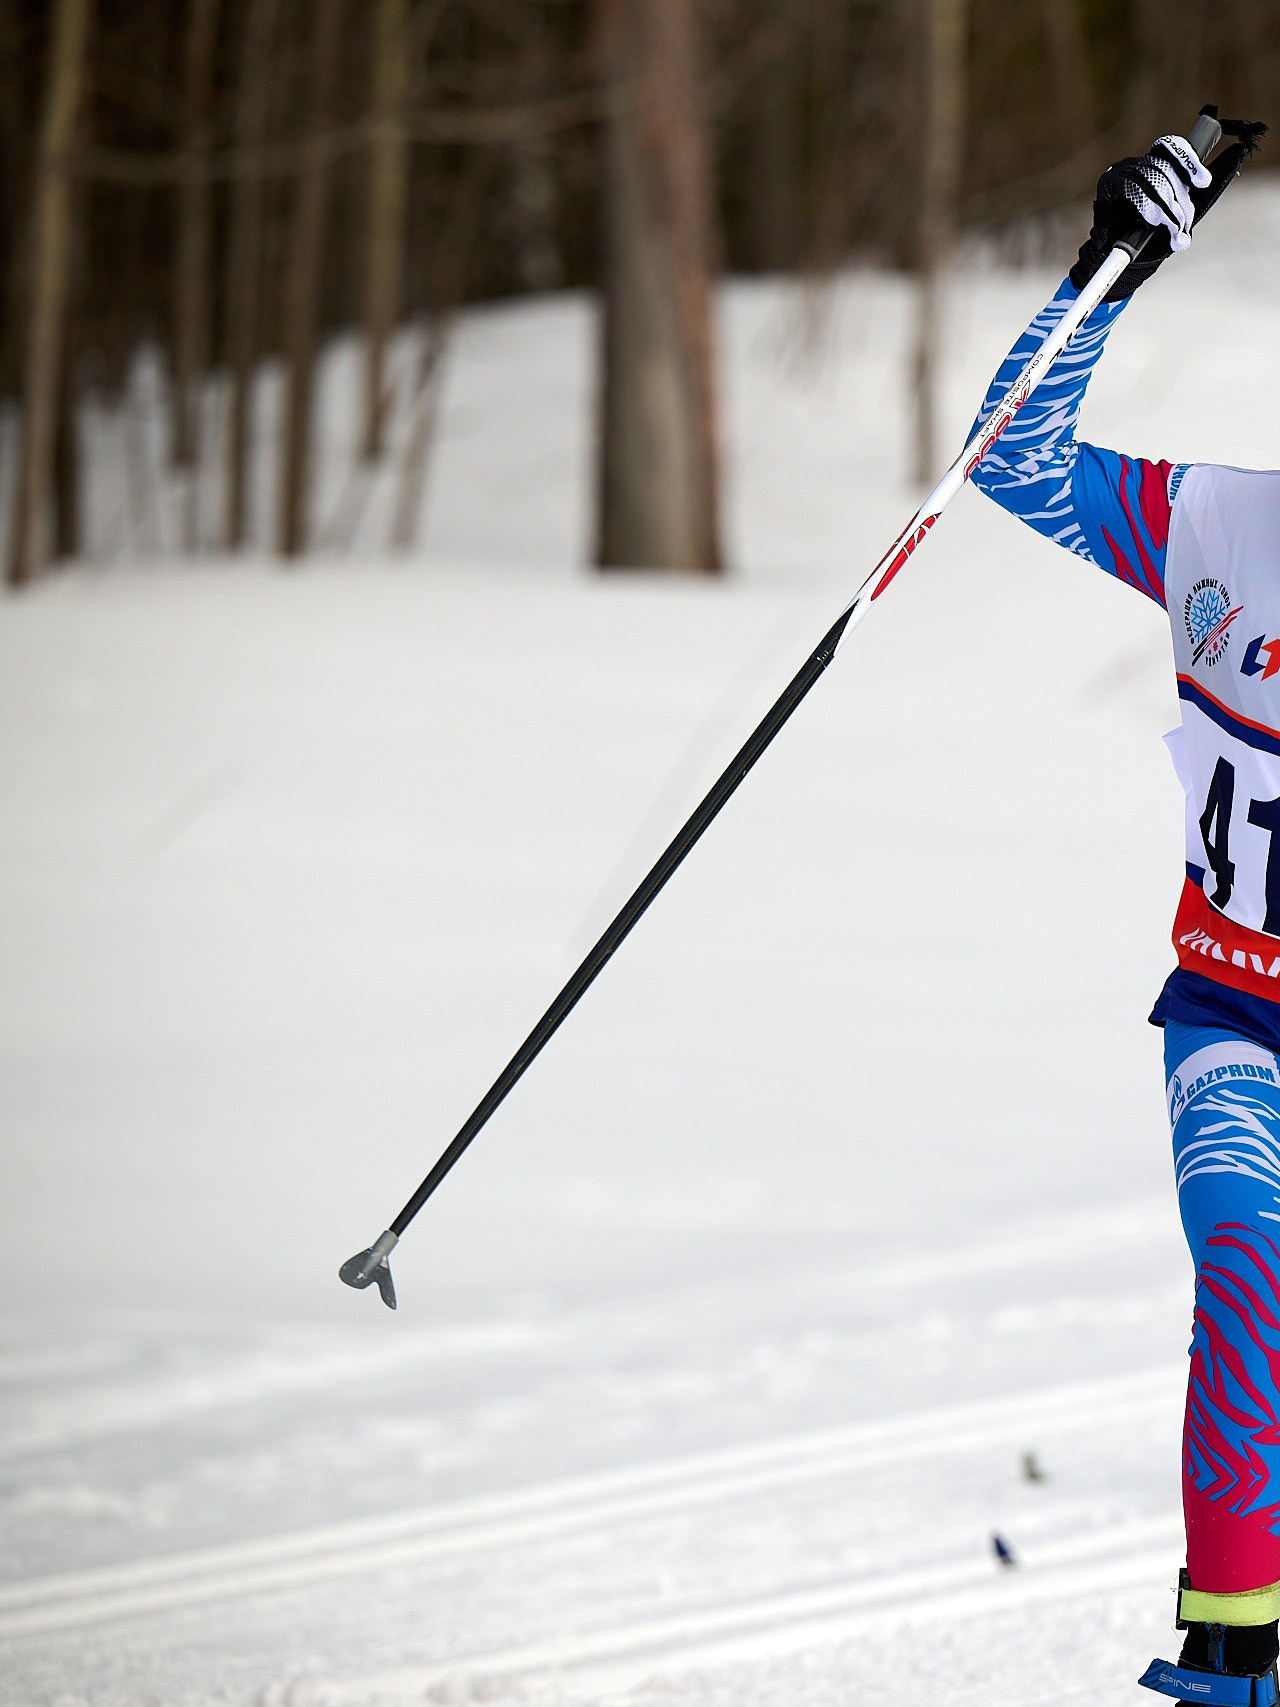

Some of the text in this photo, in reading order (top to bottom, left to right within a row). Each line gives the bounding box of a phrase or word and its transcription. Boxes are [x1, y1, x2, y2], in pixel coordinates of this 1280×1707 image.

[1004, 353, 1044, 406] COMPOSITE
[981, 408, 1004, 439] SHAFT
[1186, 1063, 1276, 1100] GAZPROM
[1159, 1673, 1211, 1693] SPINE
